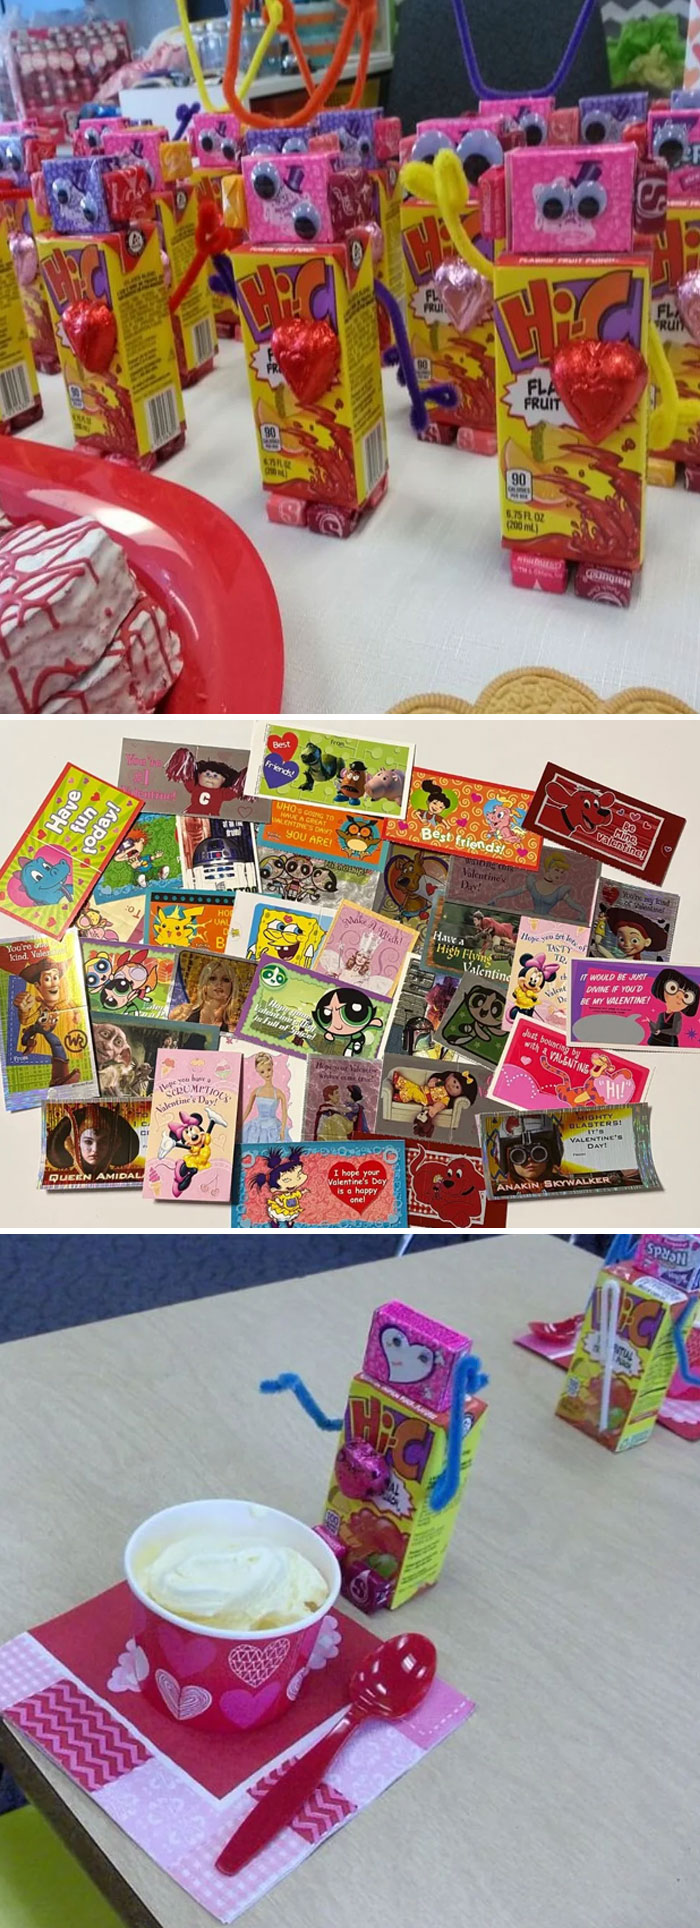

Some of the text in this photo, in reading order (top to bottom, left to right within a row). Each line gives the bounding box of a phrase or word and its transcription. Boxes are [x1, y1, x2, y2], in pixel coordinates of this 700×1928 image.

[524, 398, 560, 411] FRUIT
[511, 472, 526, 487] 90
[506, 509, 523, 520] 6.75
[534, 513, 545, 522] OZ
[199, 792, 211, 806] C
[44, 789, 82, 835] Have
[69, 805, 99, 834] fun
[81, 800, 121, 855] today!
[285, 829, 308, 842] YOU
[309, 835, 333, 848] ARE!
[421, 827, 506, 856] Best friends!
[597, 832, 648, 861] Valentine!
[433, 930, 457, 945] Have
[520, 932, 540, 944] Hope
[6, 943, 33, 953] You're
[436, 943, 493, 969] High Flying
[580, 972, 649, 982] IT WOULD BE JUST
[586, 984, 644, 994] DIVINE IF YOU'D
[580, 995, 652, 1006] BE MY VALENTINE!
[521, 1028, 538, 1041] Just
[540, 1034, 570, 1056] bouncing
[524, 1041, 540, 1053] with
[549, 1050, 590, 1075] VALENTINE
[158, 1080, 177, 1093] Hope
[155, 1095, 219, 1113] Valentine's Day!
[577, 1112, 614, 1122] MIGHTY
[569, 1119, 622, 1130] BLASTERS!
[96, 1171, 145, 1181] AMIDAL
[334, 1169, 380, 1178] I hope your
[327, 1177, 387, 1187] Valentine's Day
[355, 1186, 377, 1196] happy
[350, 1195, 366, 1204] one!
[350, 1396, 430, 1480] Hi-C
